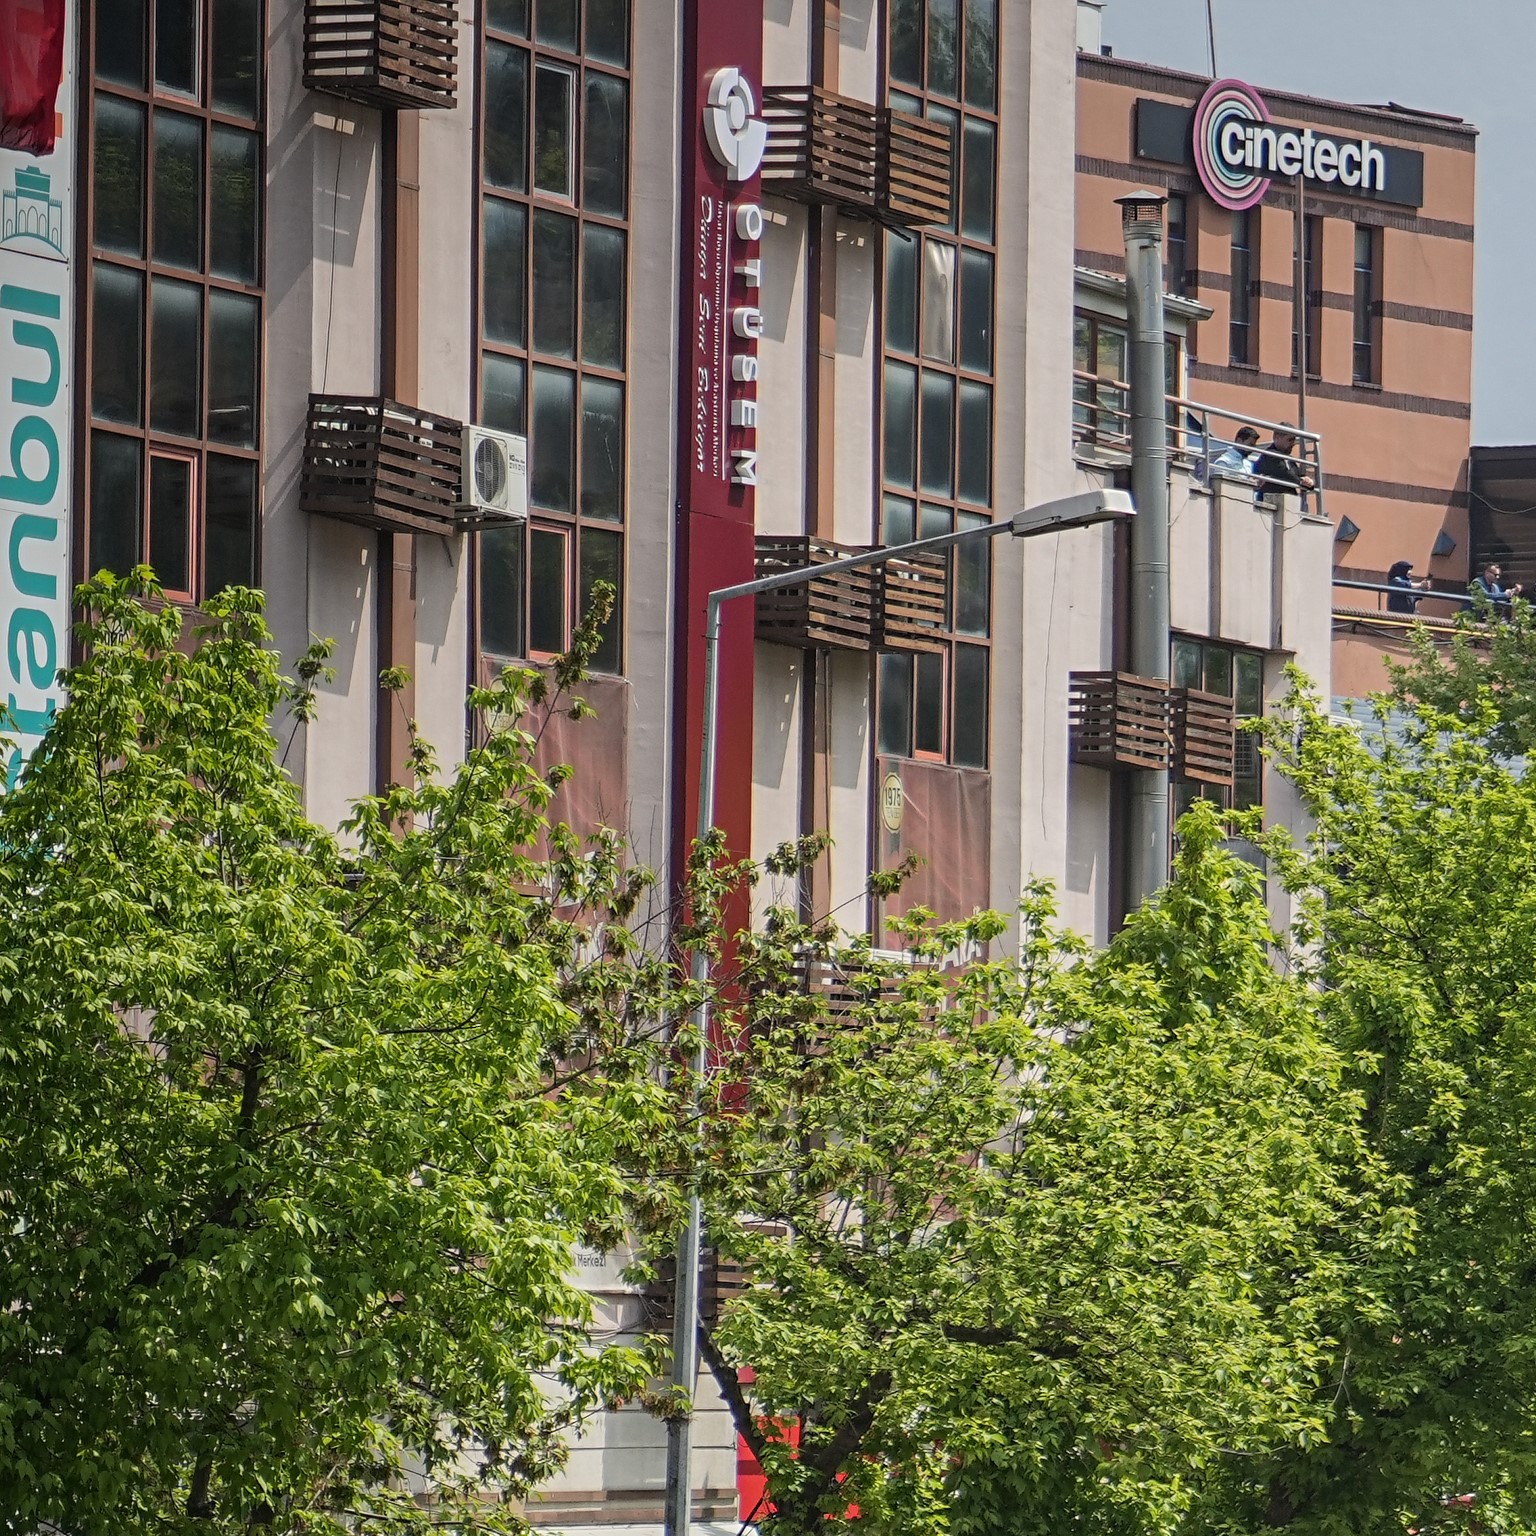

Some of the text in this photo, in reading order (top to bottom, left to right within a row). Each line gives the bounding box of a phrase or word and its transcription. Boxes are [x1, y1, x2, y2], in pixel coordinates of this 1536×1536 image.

[1221, 122, 1385, 191] cinetech
[697, 195, 713, 281] Dünya
[731, 203, 763, 487] OTÜSEM
